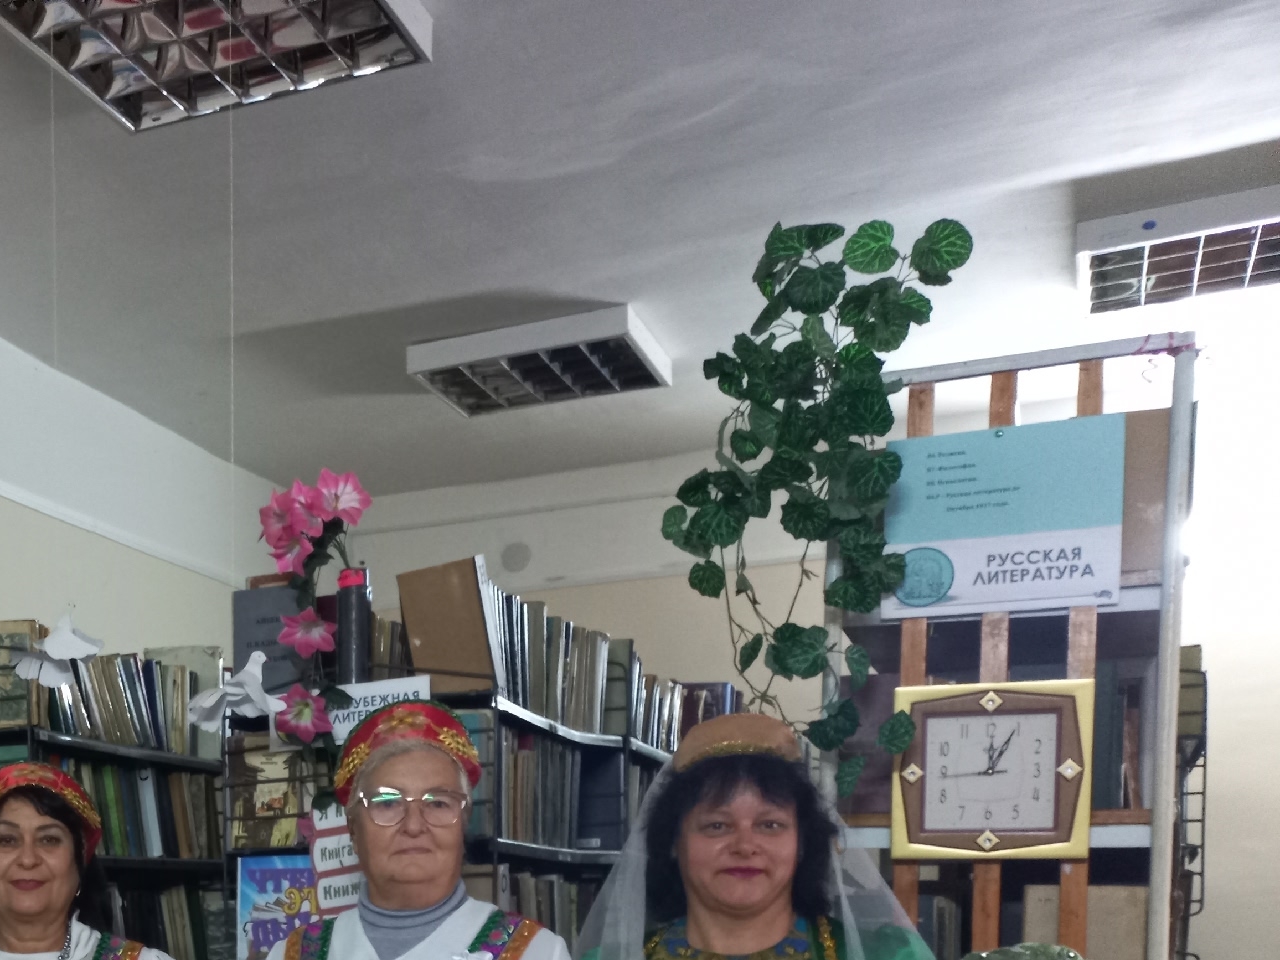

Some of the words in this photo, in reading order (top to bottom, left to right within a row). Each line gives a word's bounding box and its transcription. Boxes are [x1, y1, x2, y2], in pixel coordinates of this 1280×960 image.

[986, 546, 1083, 568] РУССКАЯ
[972, 563, 1095, 586] ЛИТЕРАТУРА
[327, 690, 420, 713] УБЕЖНАЯ
[332, 709, 371, 726] ЛИТЕР
[939, 741, 950, 757] 10
[1033, 738, 1042, 755] 2
[1033, 763, 1041, 779] 3
[939, 788, 947, 804] 8
[1032, 788, 1041, 802] 4
[957, 805, 966, 821] 7
[984, 804, 993, 820] 6
[1011, 804, 1020, 820] 5
[323, 882, 360, 901] Книж
